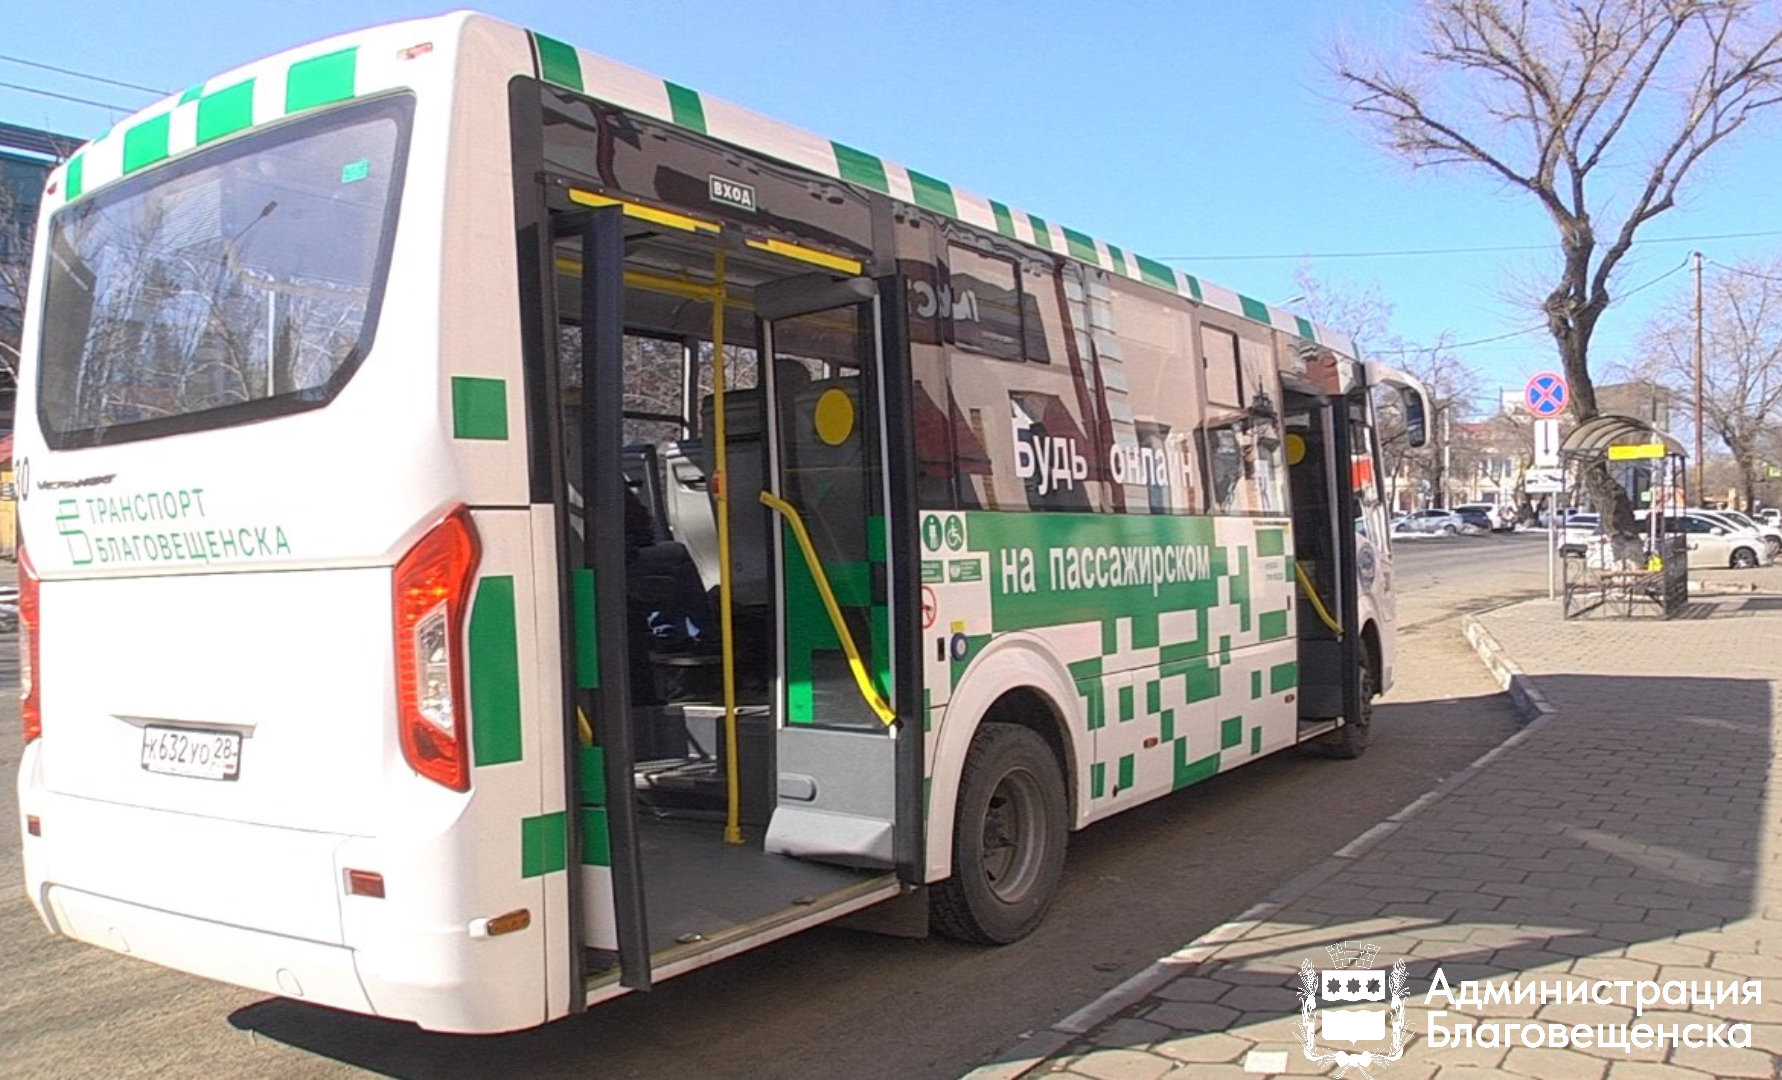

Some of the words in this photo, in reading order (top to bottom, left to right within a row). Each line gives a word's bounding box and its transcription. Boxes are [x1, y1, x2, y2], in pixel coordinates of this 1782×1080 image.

[713, 181, 752, 207] ВХОД
[1012, 417, 1088, 496] Будь
[86, 488, 205, 524] ТРАНСПОРТ
[95, 525, 292, 565] БЛАГОВЕЩЕНСКА
[1001, 547, 1036, 594] на
[1049, 544, 1210, 598] пассажирском
